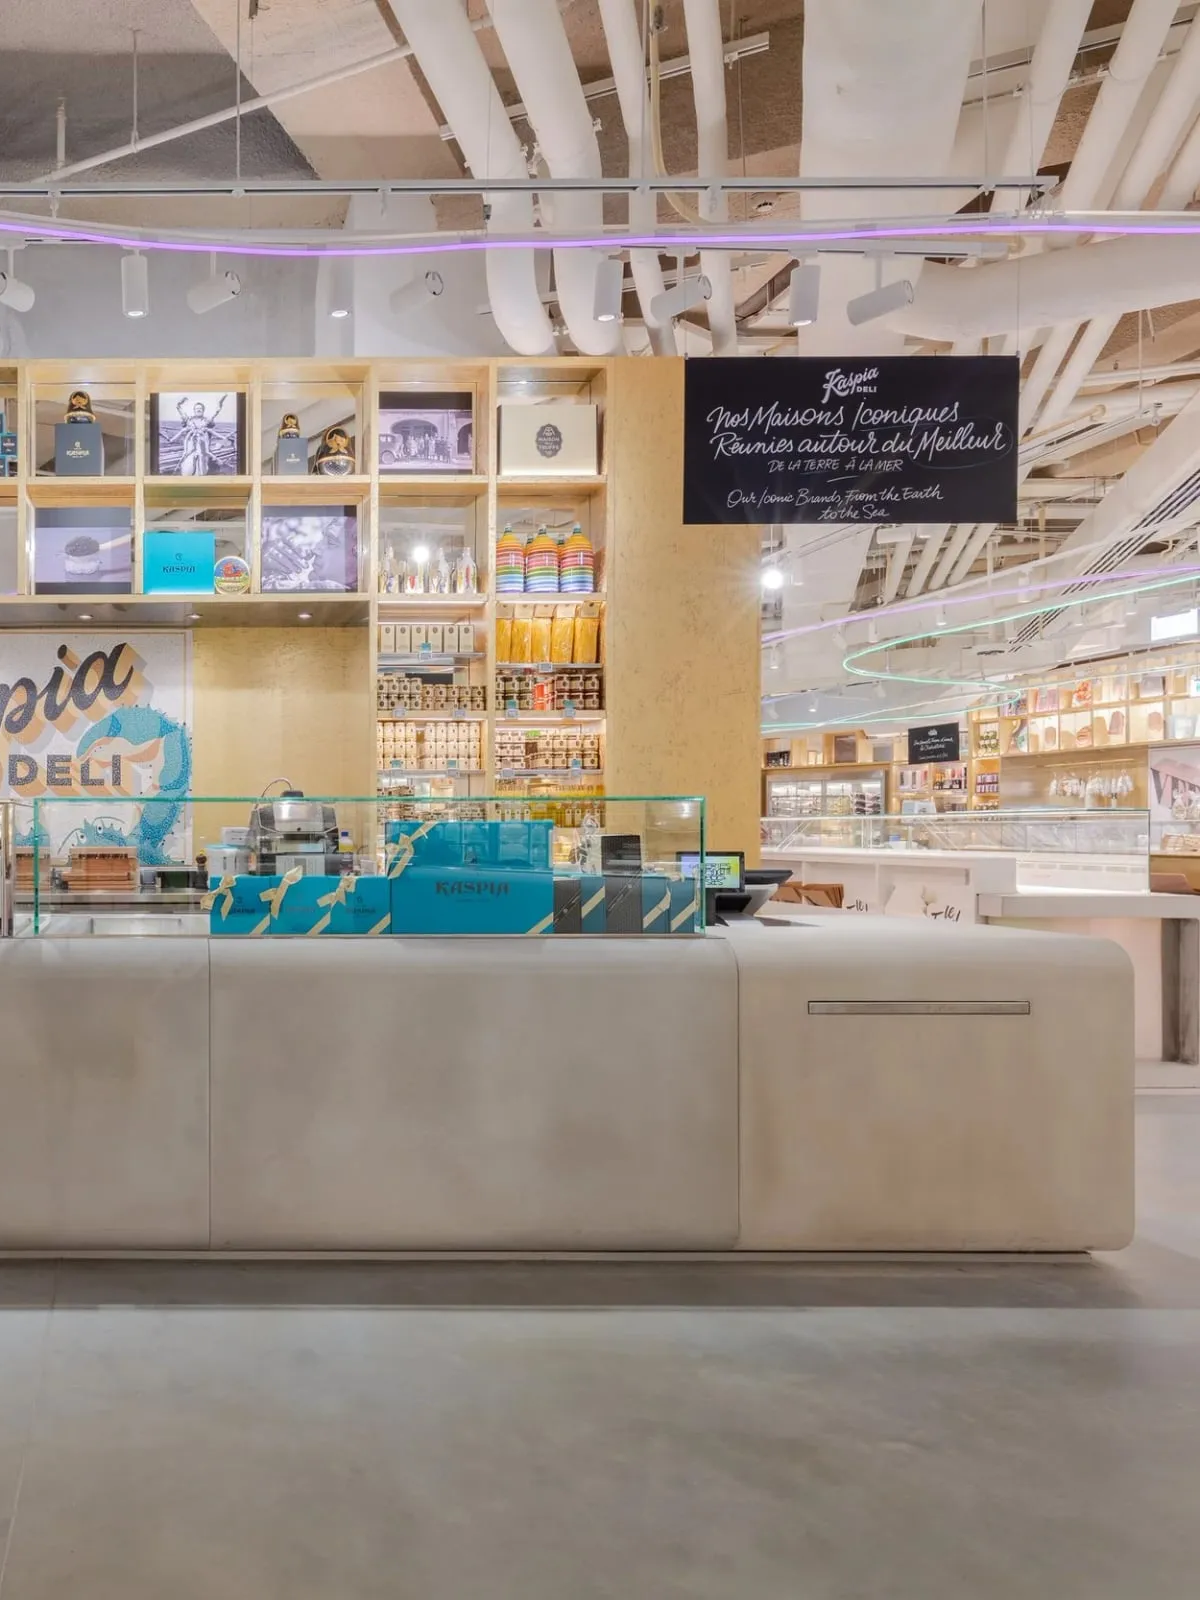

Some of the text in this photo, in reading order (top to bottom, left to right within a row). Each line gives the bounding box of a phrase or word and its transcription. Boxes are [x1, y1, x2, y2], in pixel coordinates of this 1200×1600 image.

[821, 366, 880, 404] Kaspia
[856, 385, 878, 393] DELI
[706, 397, 960, 436] Nos Maisons Iconiques
[709, 422, 1006, 461] Réunies autour du Meilleur
[767, 460, 785, 473] DE
[788, 459, 801, 471] LA
[803, 458, 840, 471] TERRE
[858, 459, 874, 471] LA
[874, 459, 904, 471] MER
[727, 489, 757, 508] Our
[756, 486, 794, 509] Iconic
[845, 489, 878, 504] From
[879, 485, 901, 502] the
[901, 484, 944, 500] Earth
[817, 504, 890, 520] to the Sea
[162, 565, 196, 573] KASPIA
[8, 754, 122, 786] DELI
[435, 880, 511, 897] KASPIA
